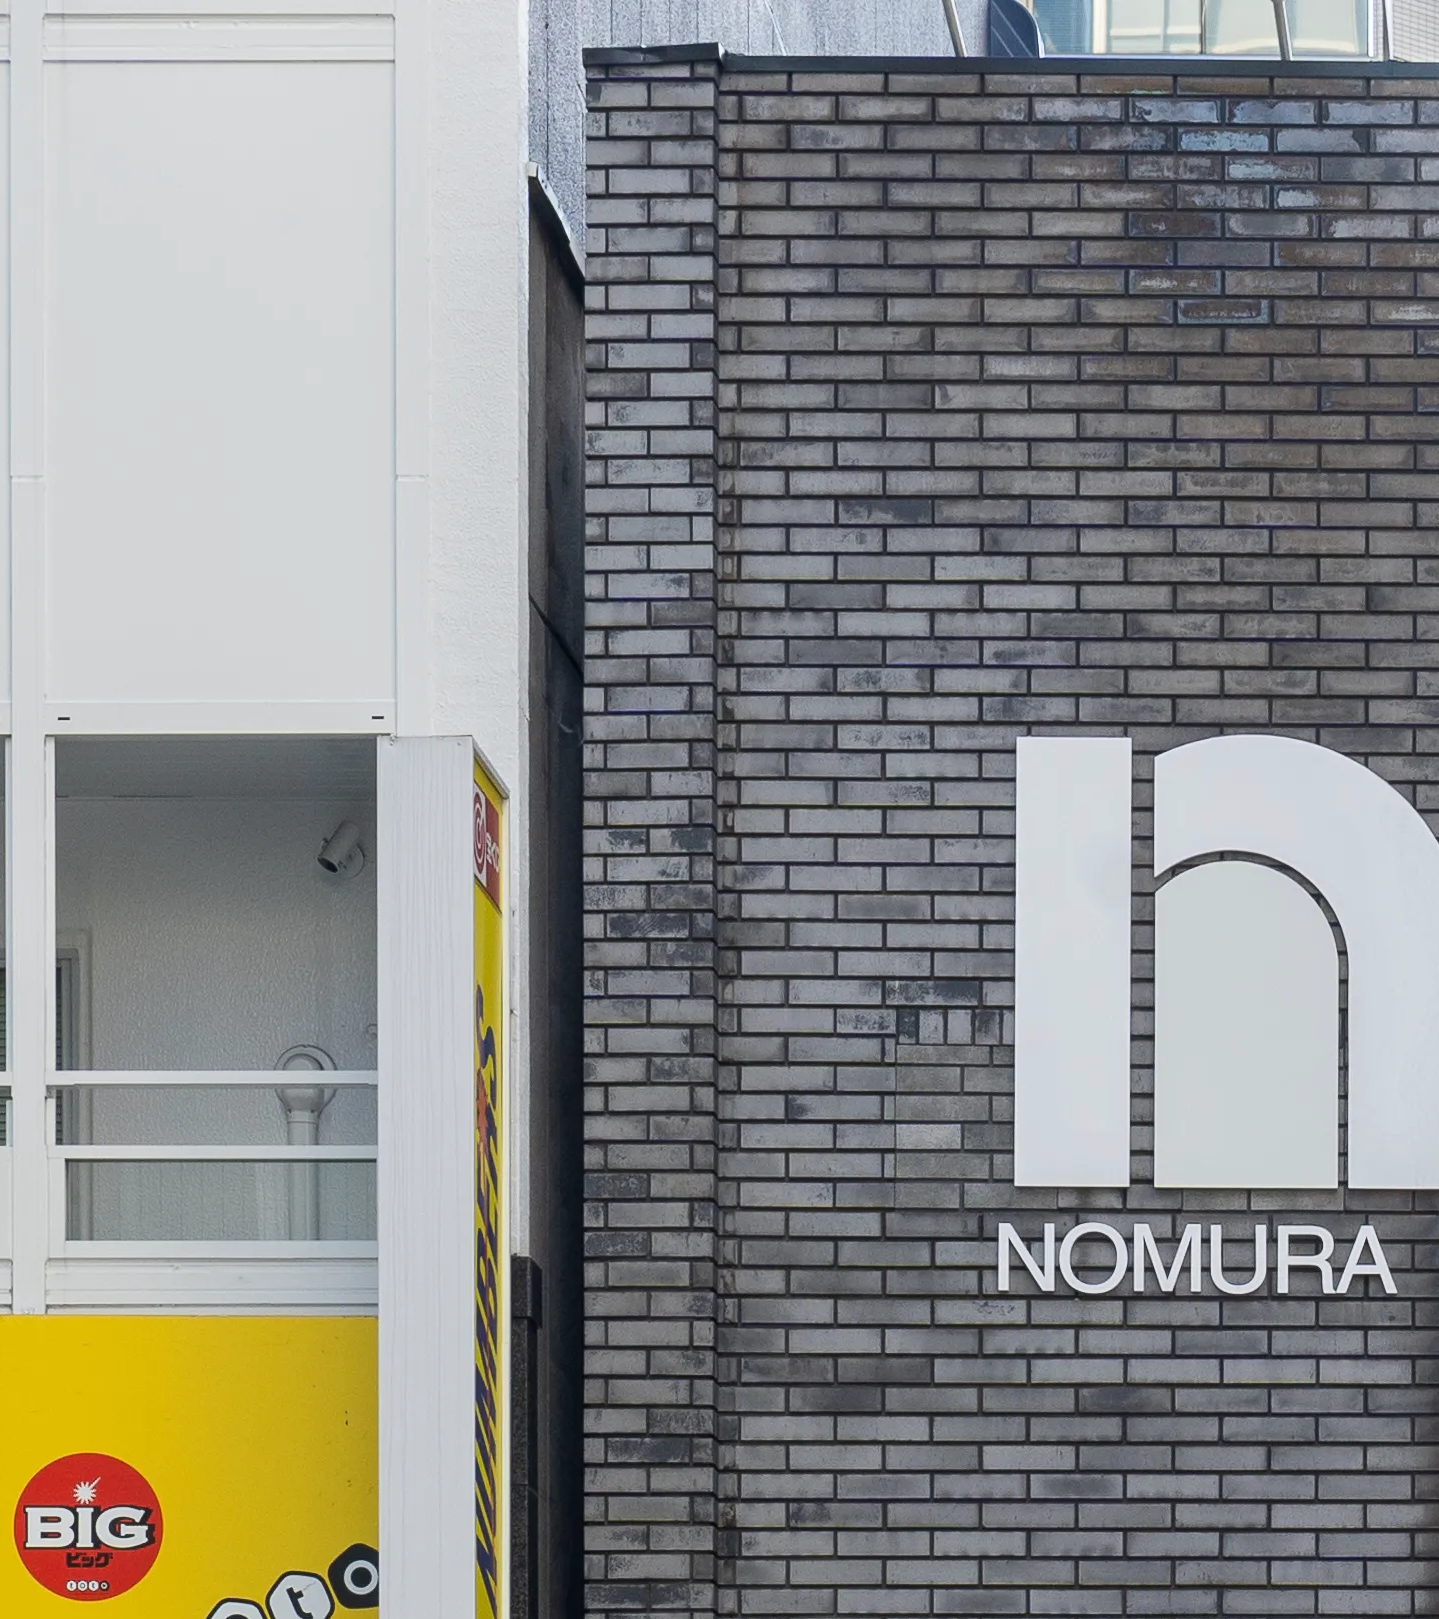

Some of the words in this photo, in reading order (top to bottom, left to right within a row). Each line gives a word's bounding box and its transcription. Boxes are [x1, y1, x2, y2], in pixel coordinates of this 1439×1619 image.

[997, 1222, 1398, 1297] NOMURA
[22, 1503, 157, 1552] BIG
[65, 1552, 112, 1569] ビッグ
[66, 1579, 109, 1592] toto
